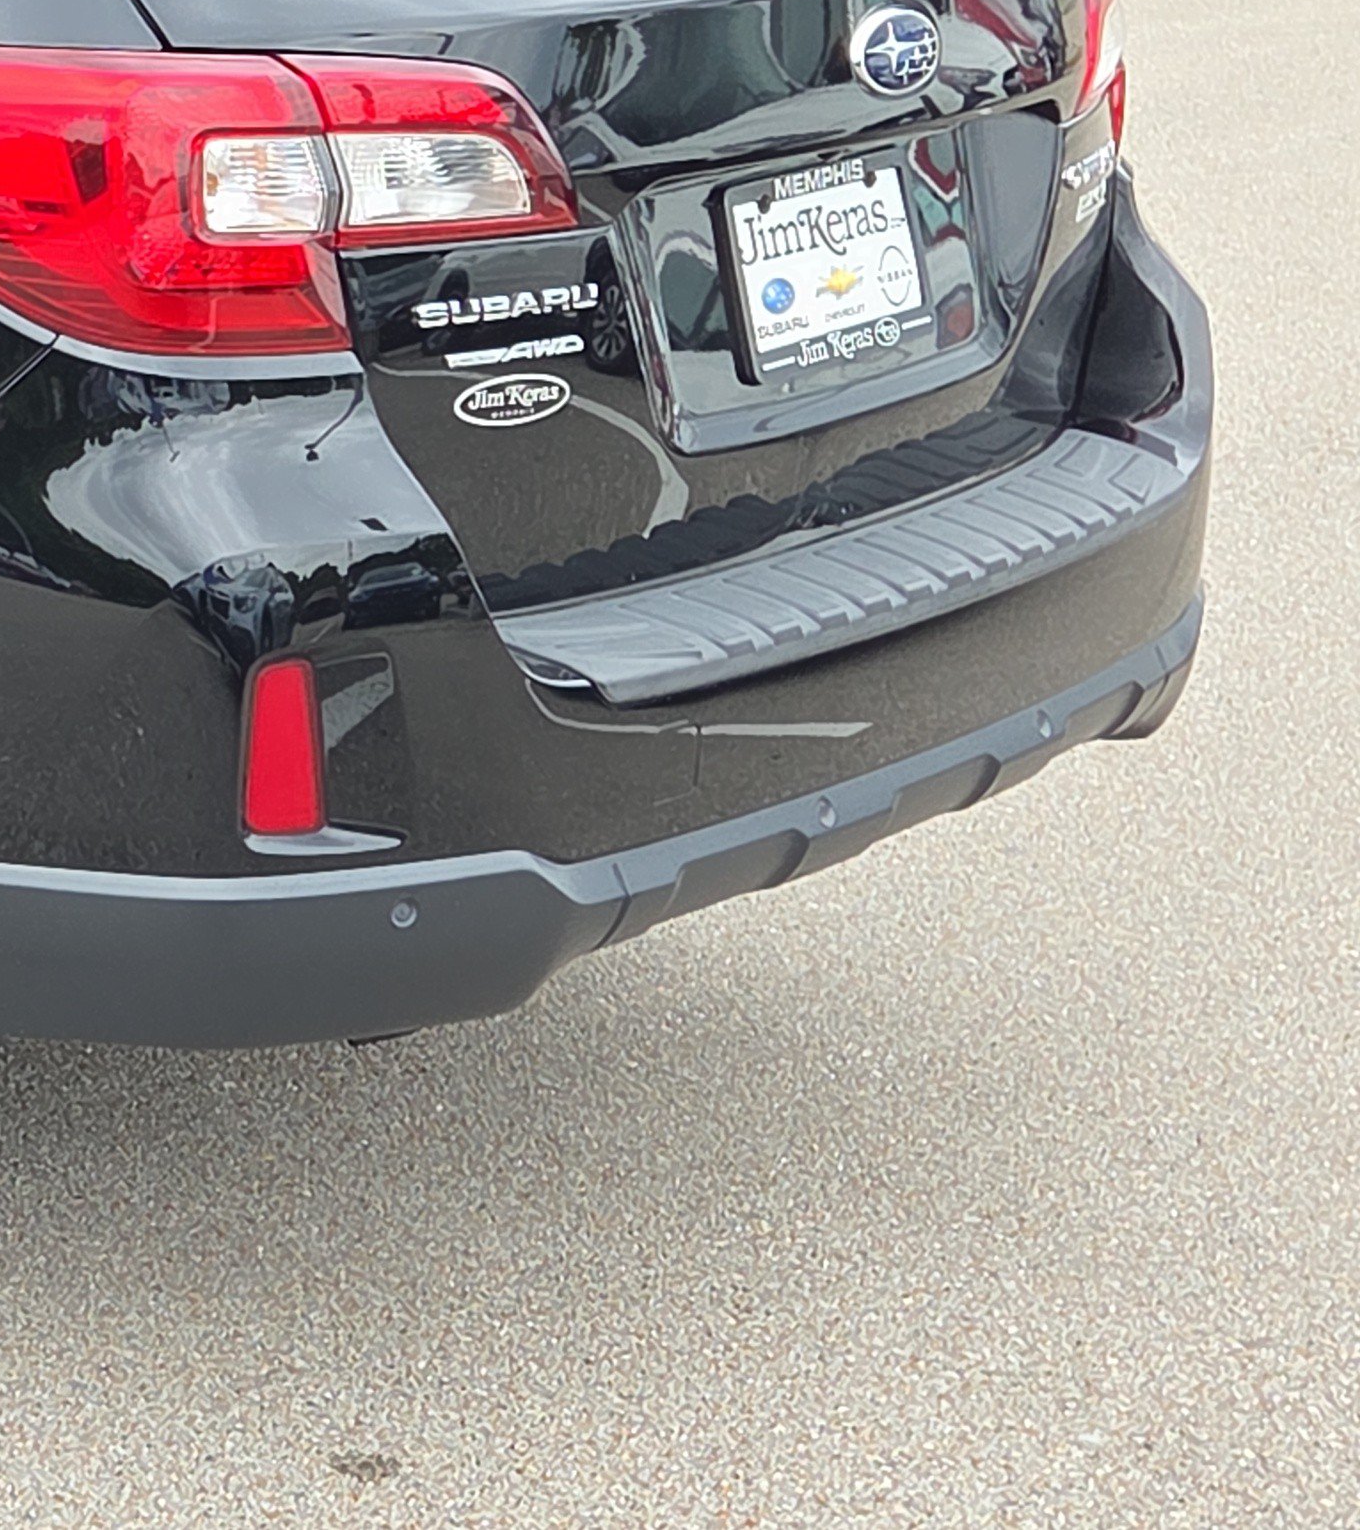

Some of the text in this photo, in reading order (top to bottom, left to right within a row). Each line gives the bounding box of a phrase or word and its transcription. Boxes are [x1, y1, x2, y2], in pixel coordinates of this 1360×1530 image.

[773, 158, 864, 202] MEMPHIS
[411, 282, 599, 329] SUBARU
[500, 334, 585, 362] AWD
[796, 327, 874, 367] Jim Keras
